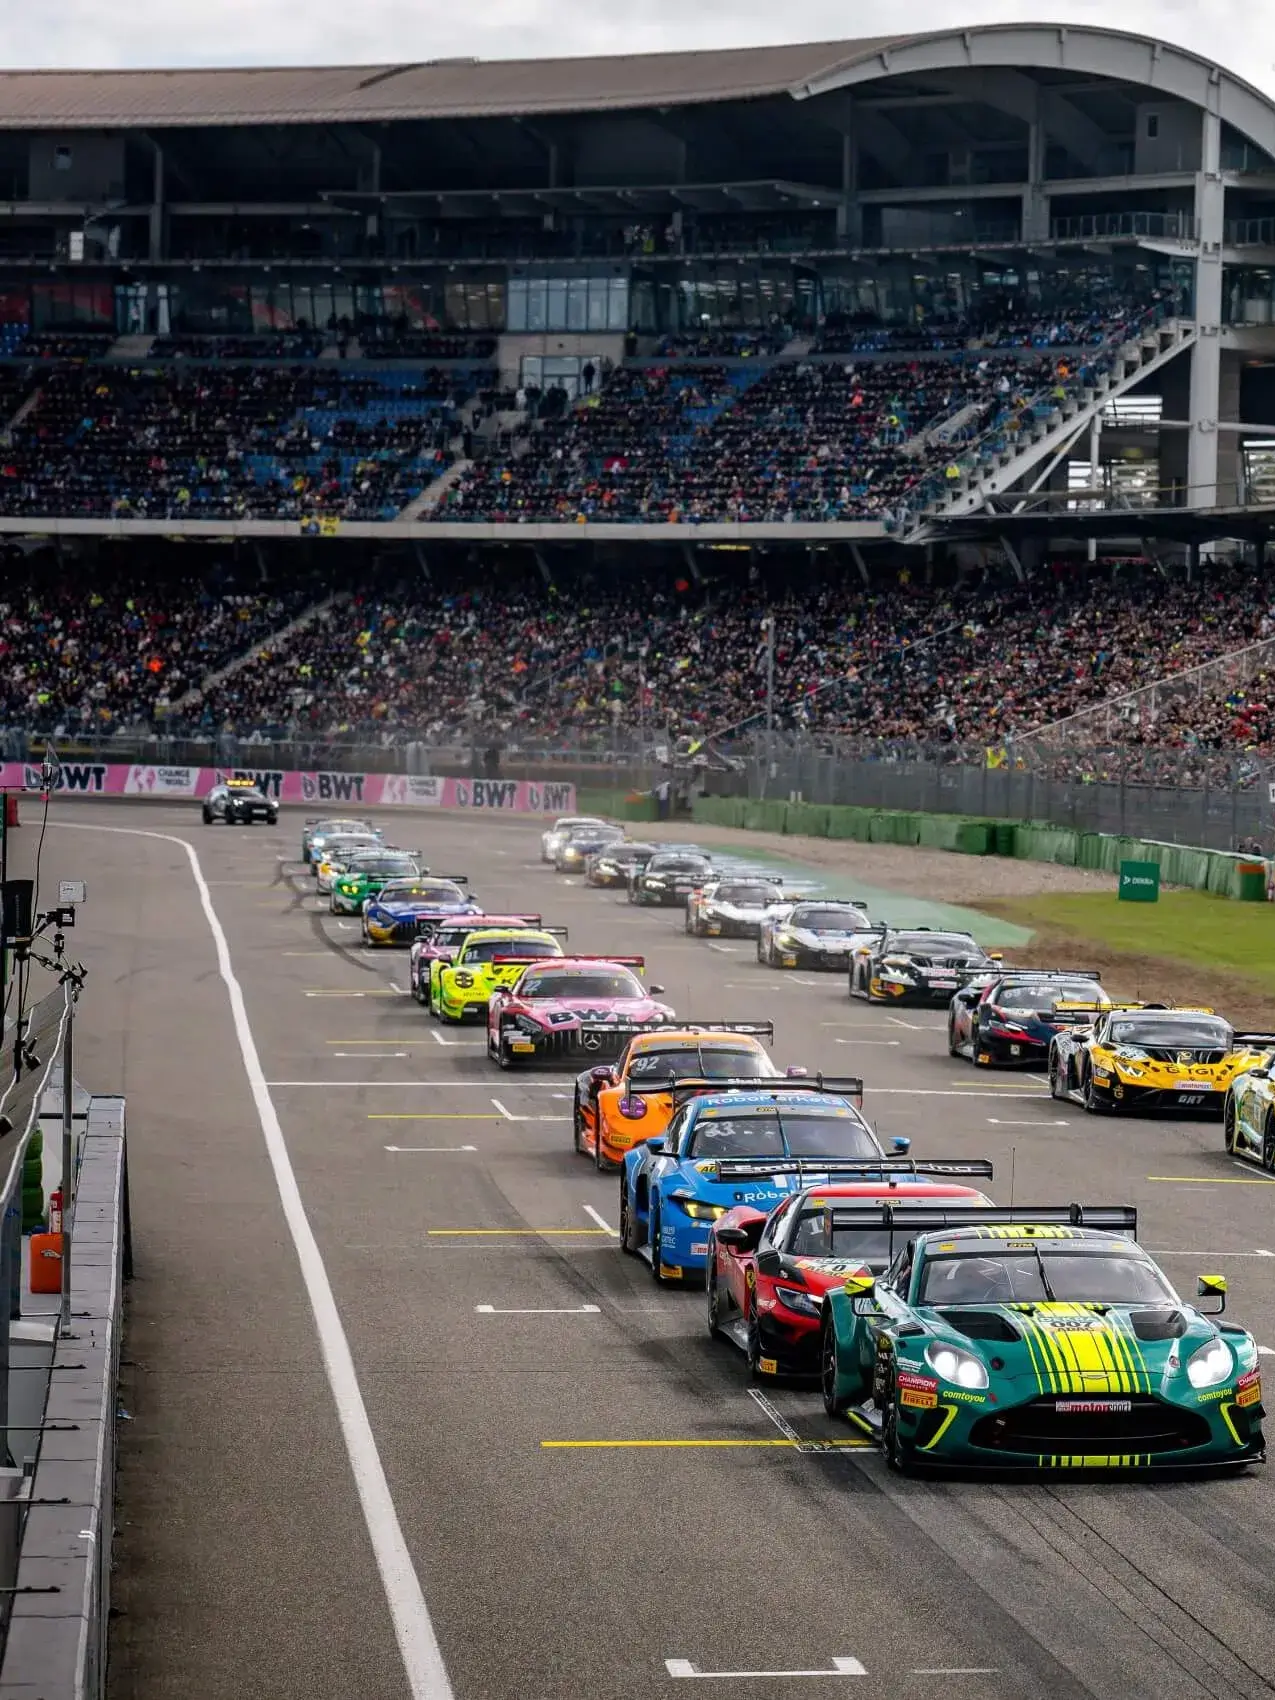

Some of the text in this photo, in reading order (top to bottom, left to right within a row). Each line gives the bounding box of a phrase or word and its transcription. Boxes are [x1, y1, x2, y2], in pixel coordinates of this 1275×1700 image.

[318, 774, 365, 800] BWT
[472, 783, 517, 808] BWT
[637, 1056, 658, 1072] 92
[898, 1375, 937, 1388] CHAMPION
[943, 1390, 986, 1403] comtoyou
[1197, 1387, 1233, 1402] comtoyou
